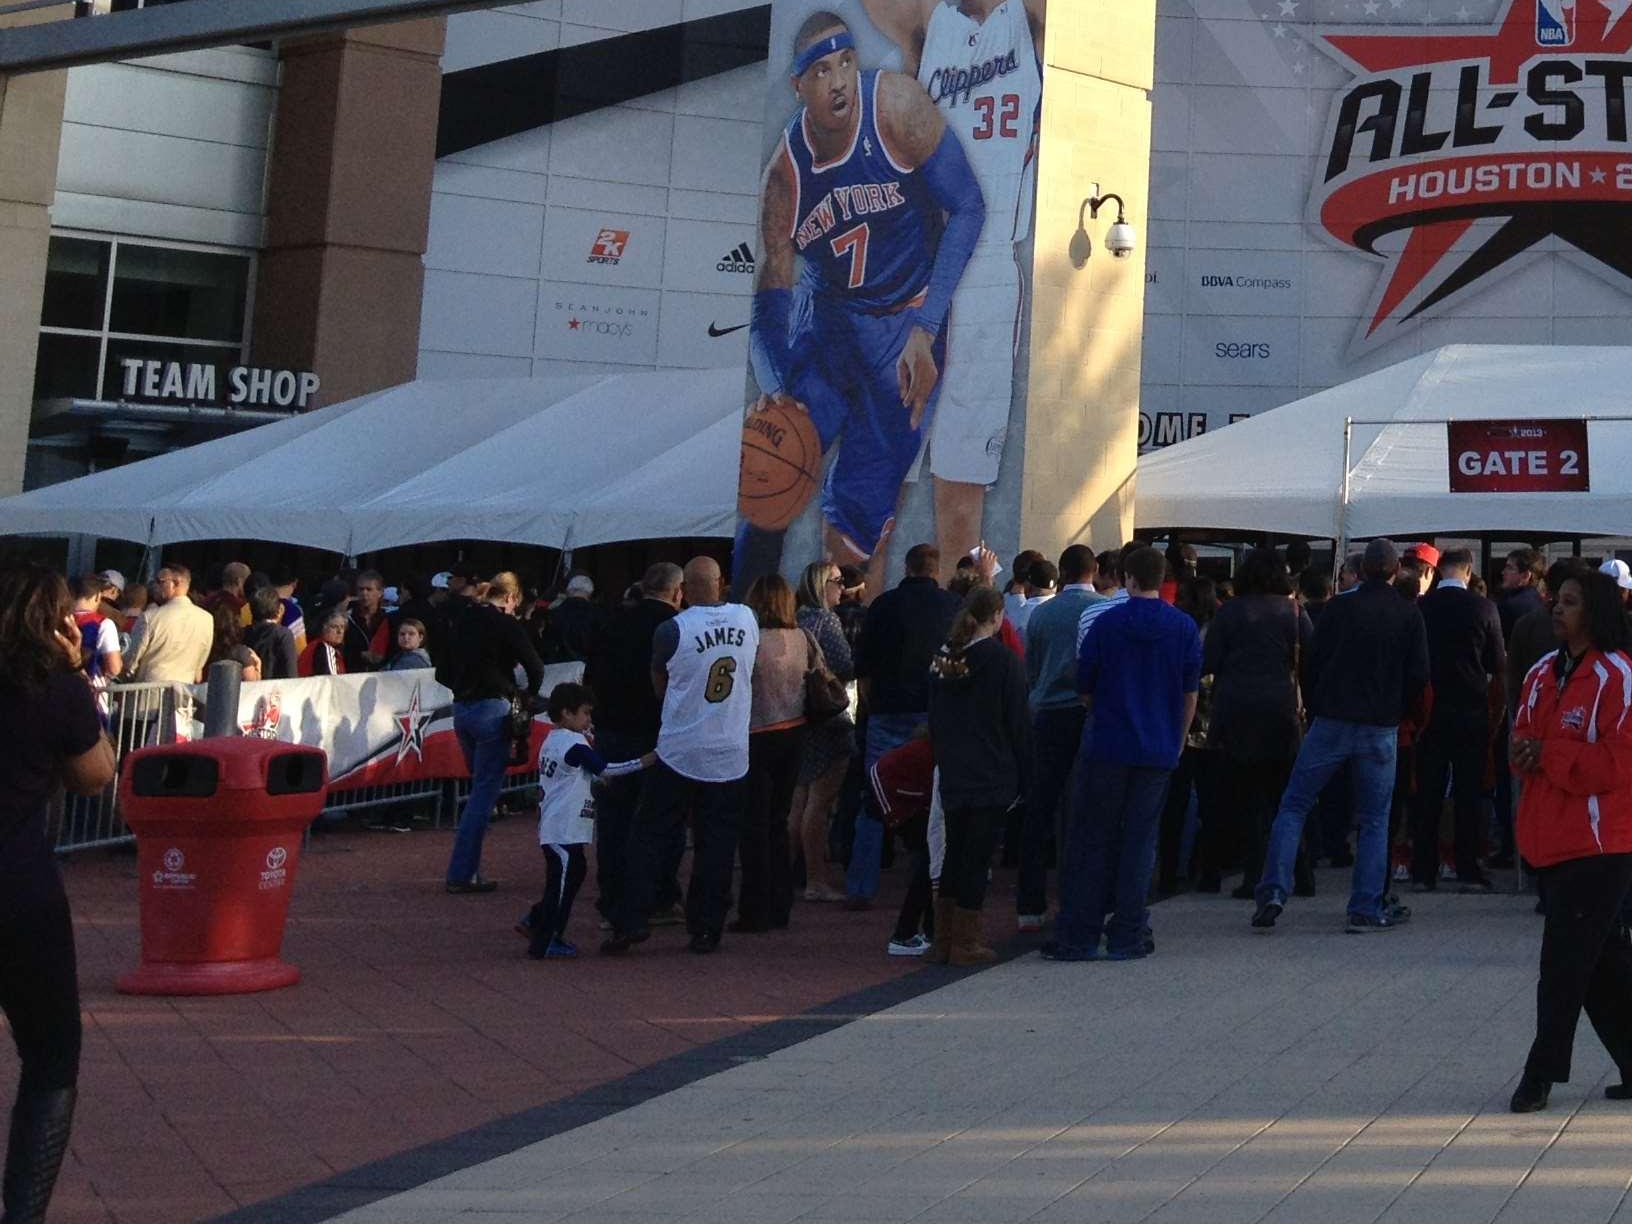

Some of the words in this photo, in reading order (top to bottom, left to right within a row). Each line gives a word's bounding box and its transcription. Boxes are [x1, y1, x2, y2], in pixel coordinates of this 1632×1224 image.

[1540, 27, 1563, 41] NBA
[928, 48, 1019, 109] Clippers
[972, 94, 1020, 140] 32
[1388, 162, 1581, 205] HOUSTON
[796, 192, 836, 250] NEW
[833, 181, 906, 221] YORK
[598, 230, 625, 256] 2K
[830, 222, 870, 289] 7
[586, 256, 620, 265] SPORTS
[716, 262, 755, 274] adida
[1201, 275, 1234, 287] BBVA
[1236, 276, 1293, 289] Compass
[1215, 342, 1270, 359] sears
[121, 357, 217, 401] TEAM
[231, 368, 321, 409] SHOP
[1458, 450, 1549, 476] GATE
[1559, 449, 1579, 475] 2
[695, 627, 746, 654] JAMES
[704, 656, 737, 703] 6
